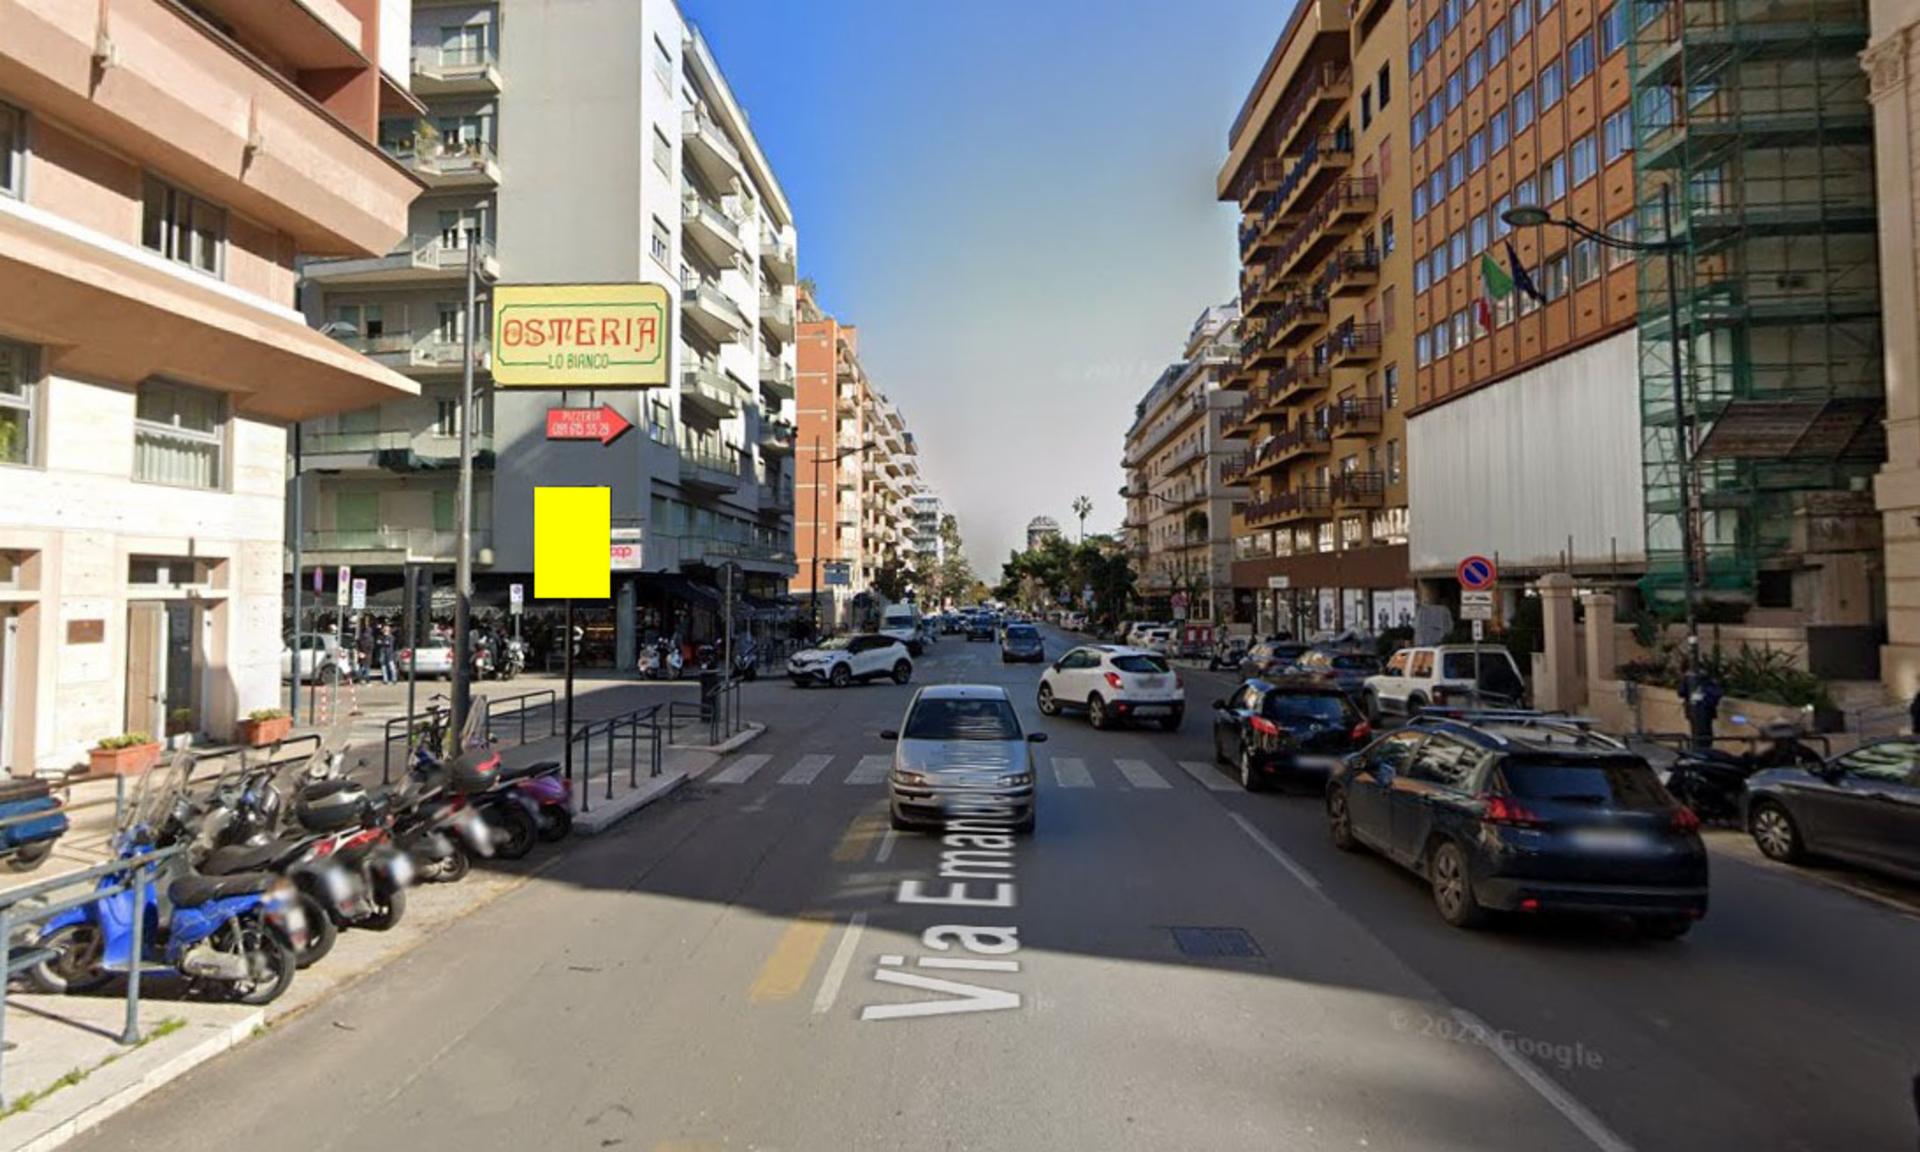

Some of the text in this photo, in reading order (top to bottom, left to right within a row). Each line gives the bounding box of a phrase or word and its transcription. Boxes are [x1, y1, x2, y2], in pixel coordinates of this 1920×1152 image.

[503, 317, 657, 353] OSTERIA
[548, 353, 610, 369] LO BIANCO
[610, 546, 632, 559] oop
